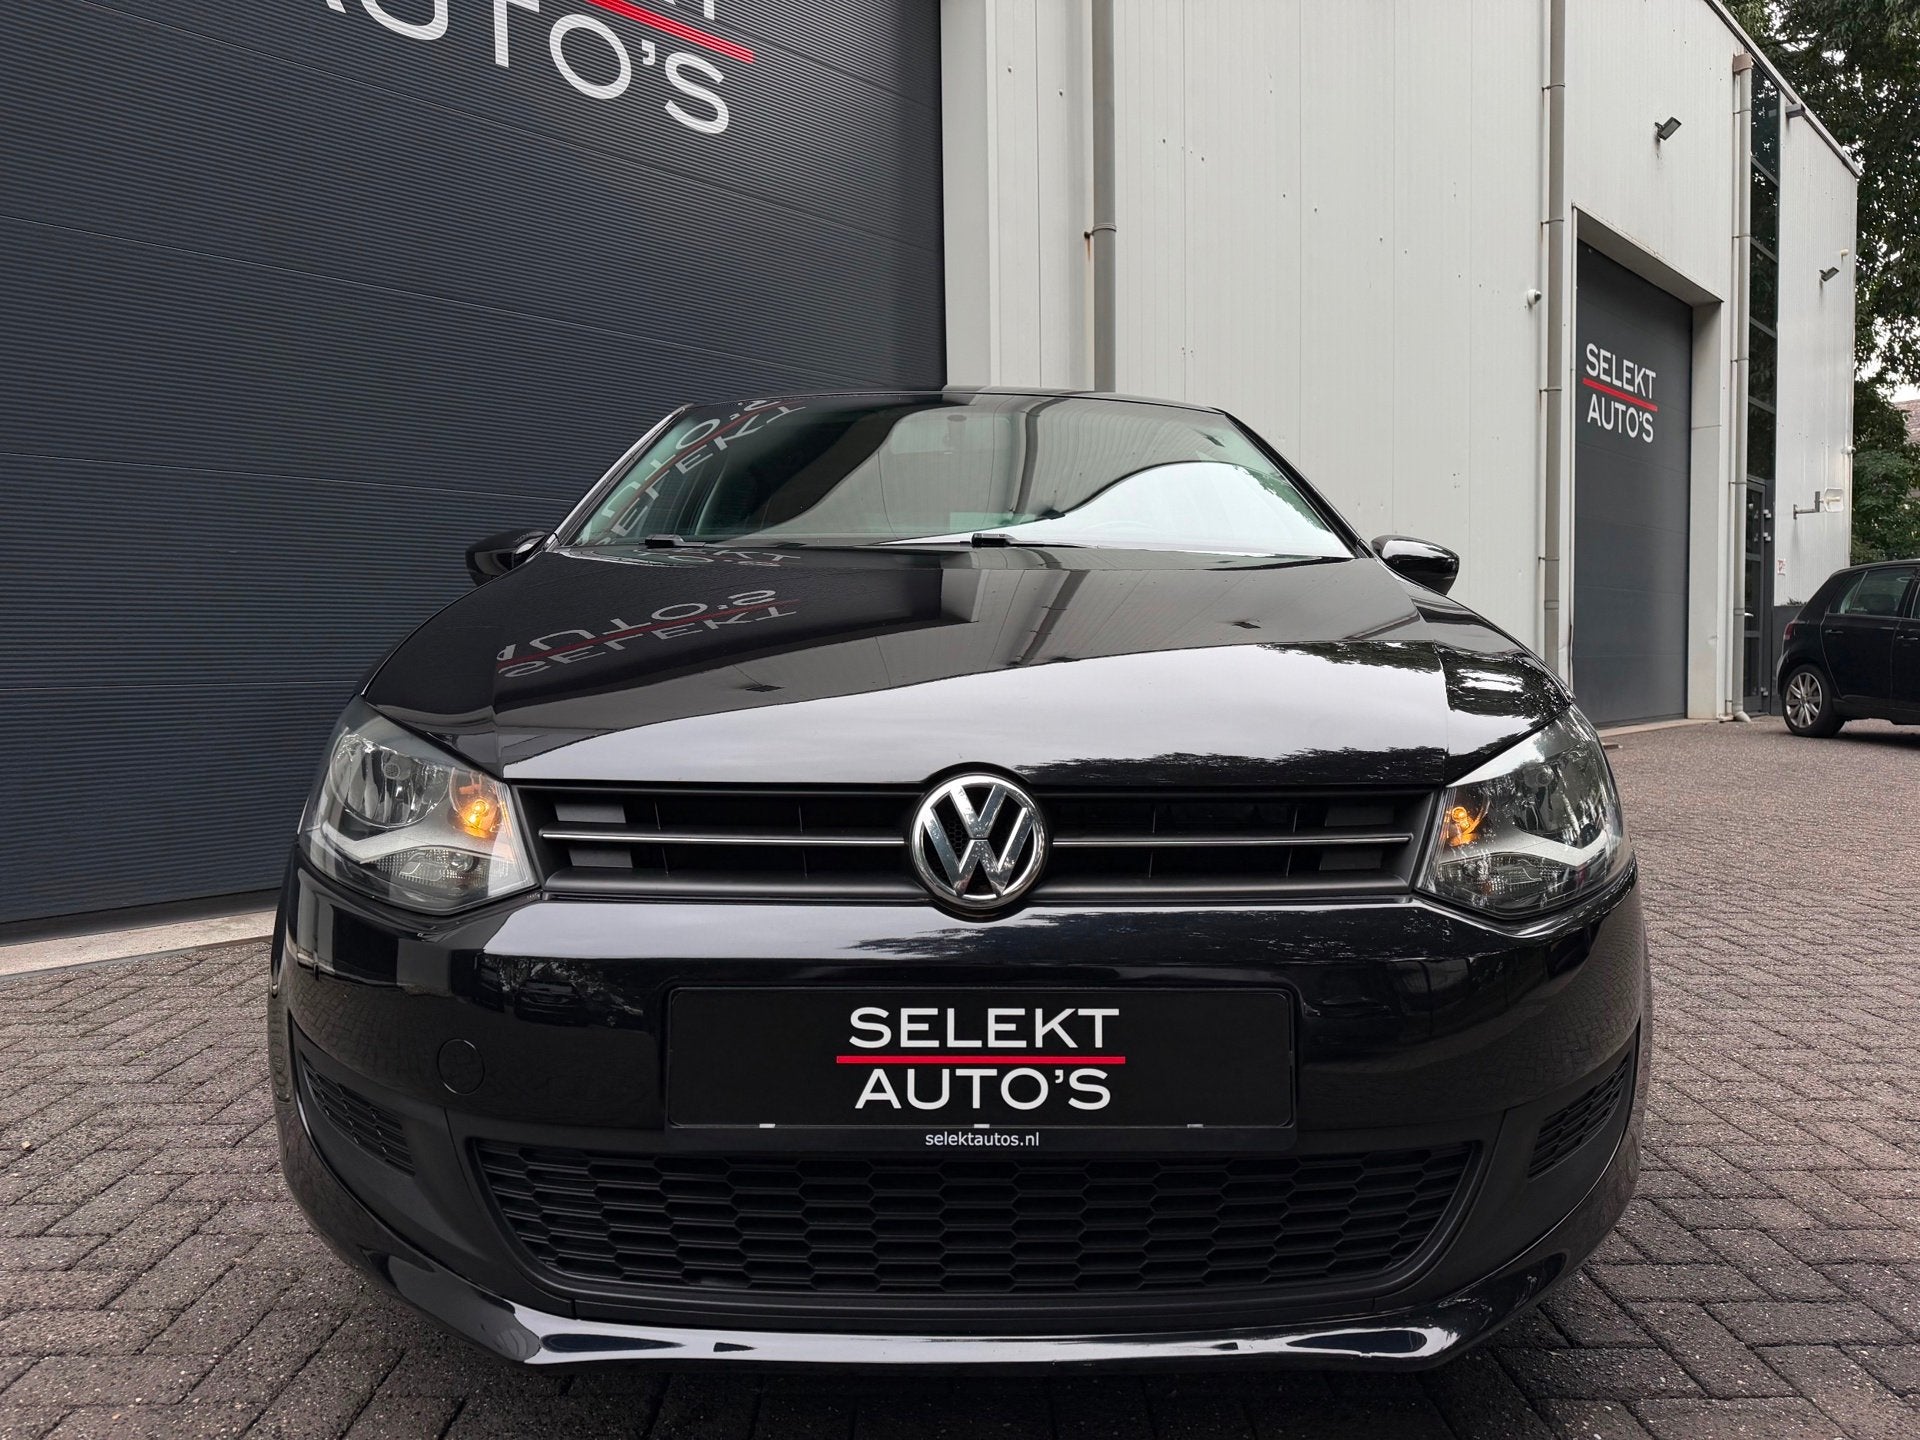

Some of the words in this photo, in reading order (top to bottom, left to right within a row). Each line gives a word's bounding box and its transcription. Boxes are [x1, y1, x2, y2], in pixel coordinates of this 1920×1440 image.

[326, 0, 729, 134] UTO'S
[1585, 343, 1656, 399] SELEKT
[1587, 393, 1654, 443] AUTO'S
[916, 779, 1039, 899] VW
[848, 1006, 1120, 1049] SELEKT
[854, 1067, 1111, 1110] AUTO'S
[924, 1131, 1040, 1147] selektautos.nl
